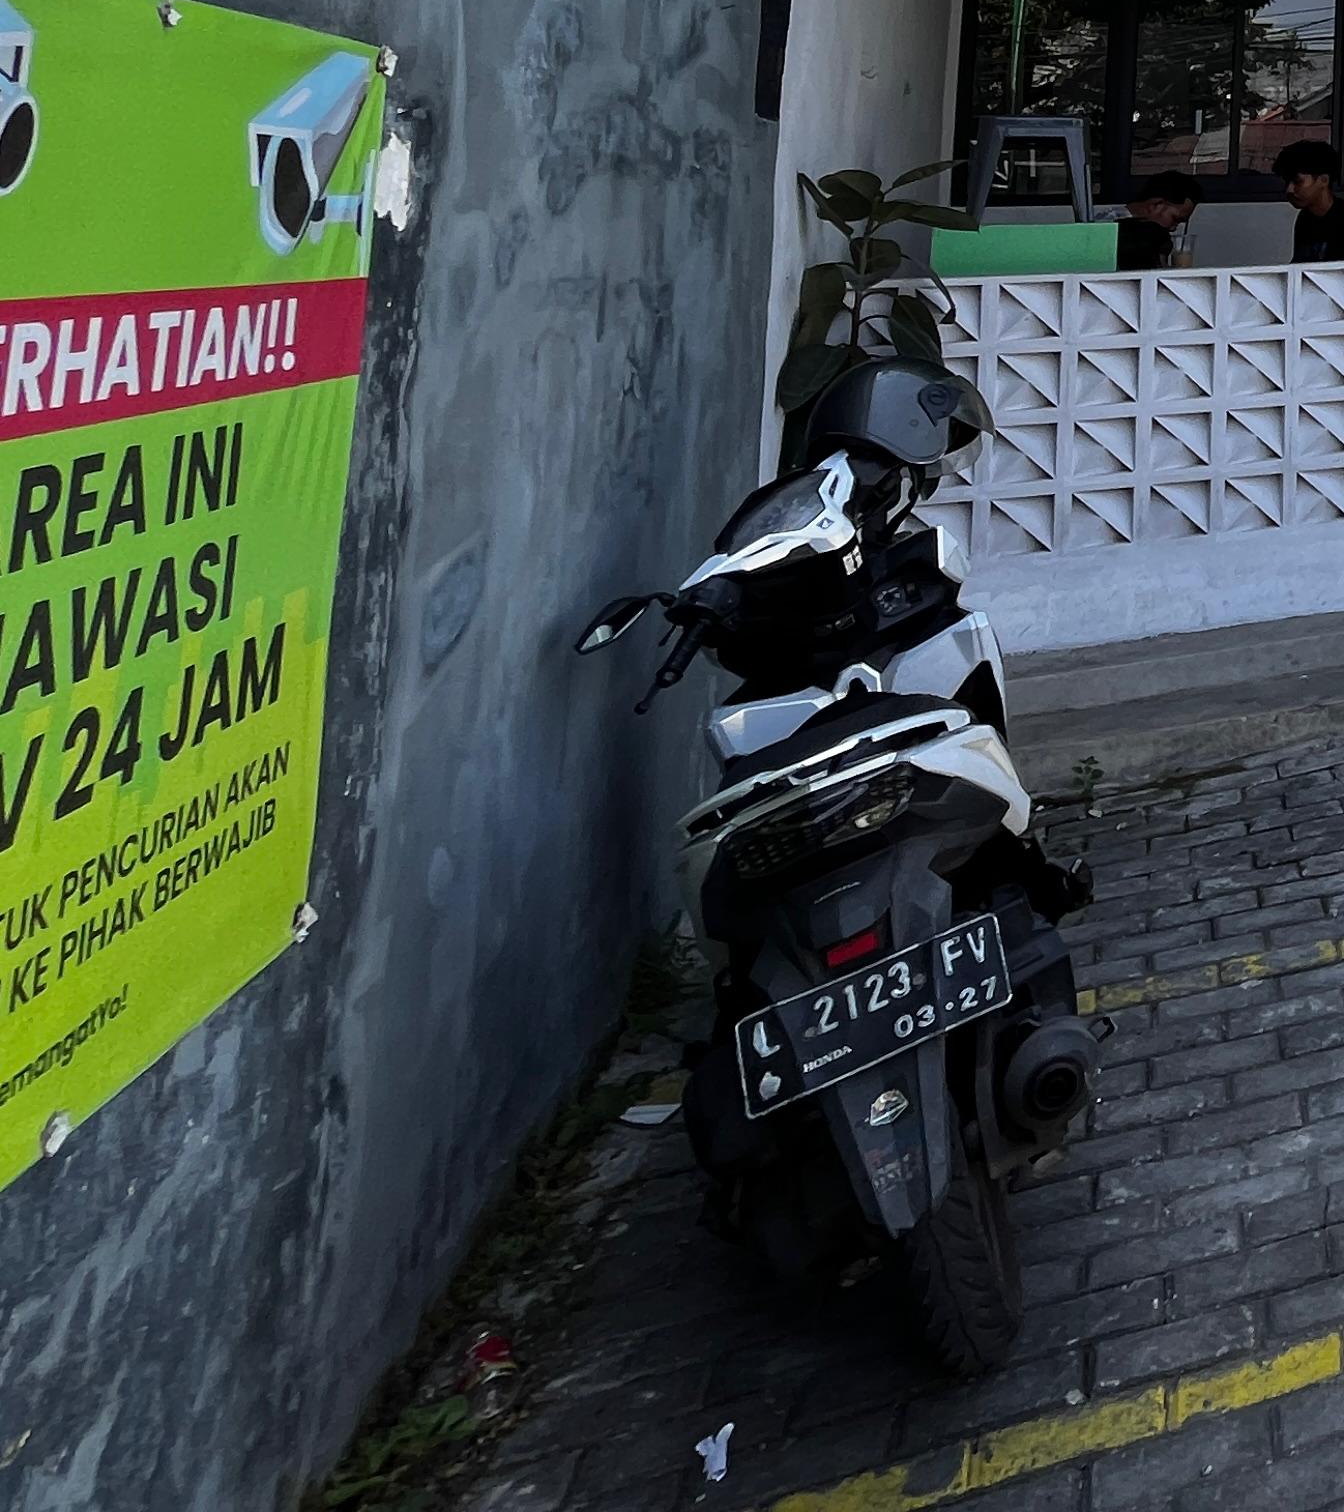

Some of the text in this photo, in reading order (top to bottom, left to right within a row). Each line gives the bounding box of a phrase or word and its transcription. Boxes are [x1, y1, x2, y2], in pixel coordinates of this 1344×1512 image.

[165, 422, 243, 525] INI
[0, 534, 240, 715] AWASI
[54, 686, 144, 822] 24
[159, 622, 286, 761] JAM
[9, 798, 276, 1014] KE PIHAK BERWAJIB
[58, 783, 220, 919] PENCURIAN
[224, 741, 291, 813] AKAN
[753, 927, 985, 1058] L 2123 FV
[802, 1045, 853, 1073] HONDA
